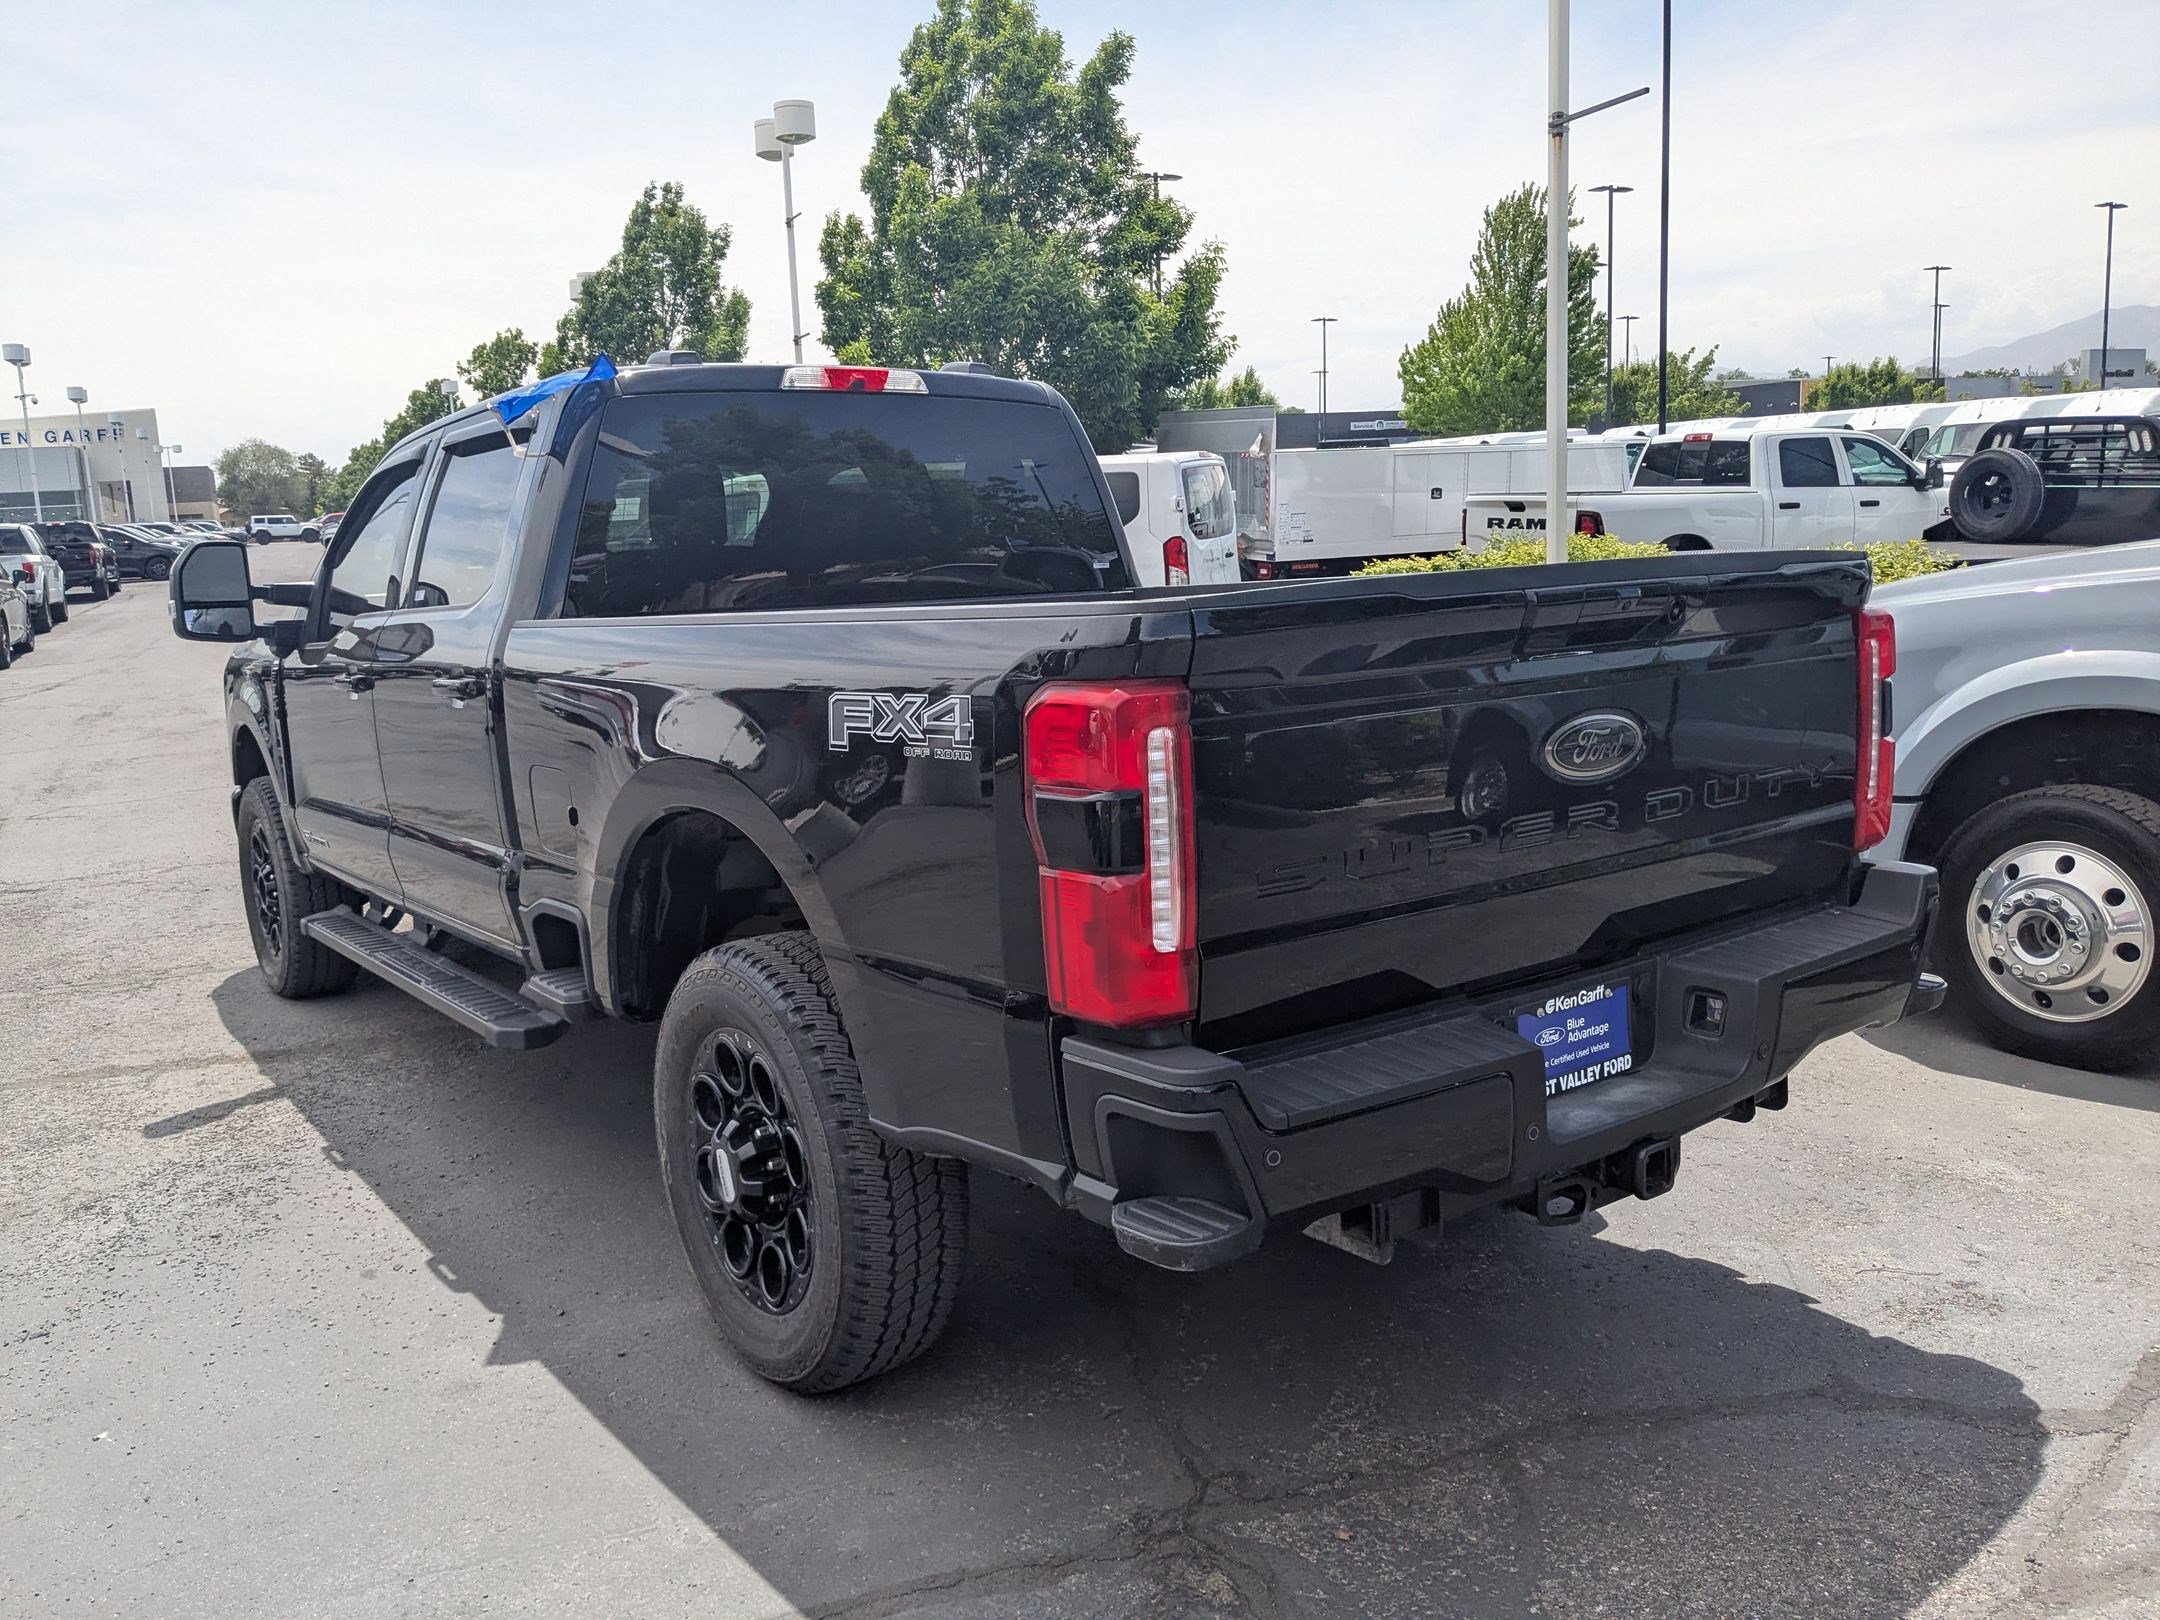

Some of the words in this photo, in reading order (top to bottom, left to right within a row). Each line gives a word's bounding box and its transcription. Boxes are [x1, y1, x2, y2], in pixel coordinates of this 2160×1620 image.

[0, 431, 29, 445] EN
[1487, 517, 1546, 530] RAM
[829, 692, 974, 751] FX4
[904, 746, 930, 757] OFF
[934, 748, 973, 761] ROAD
[1572, 728, 1624, 765] Ford
[1256, 800, 1621, 899] SUPER
[1645, 755, 1837, 823] DUTY
[1555, 995, 1577, 1012] Ken
[1578, 985, 1605, 1005] Garff
[1567, 1016, 1585, 1030] Blue
[1567, 1022, 1609, 1043] Advantage
[1540, 1030, 1560, 1044] Ford
[1550, 1053, 1575, 1066] Certified
[1576, 1048, 1590, 1058] Used
[1590, 1041, 1610, 1053] Vehicle
[1546, 1078, 1557, 1096] ST
[1560, 1064, 1601, 1091] VALLEY
[1604, 1054, 1632, 1077] FORD
